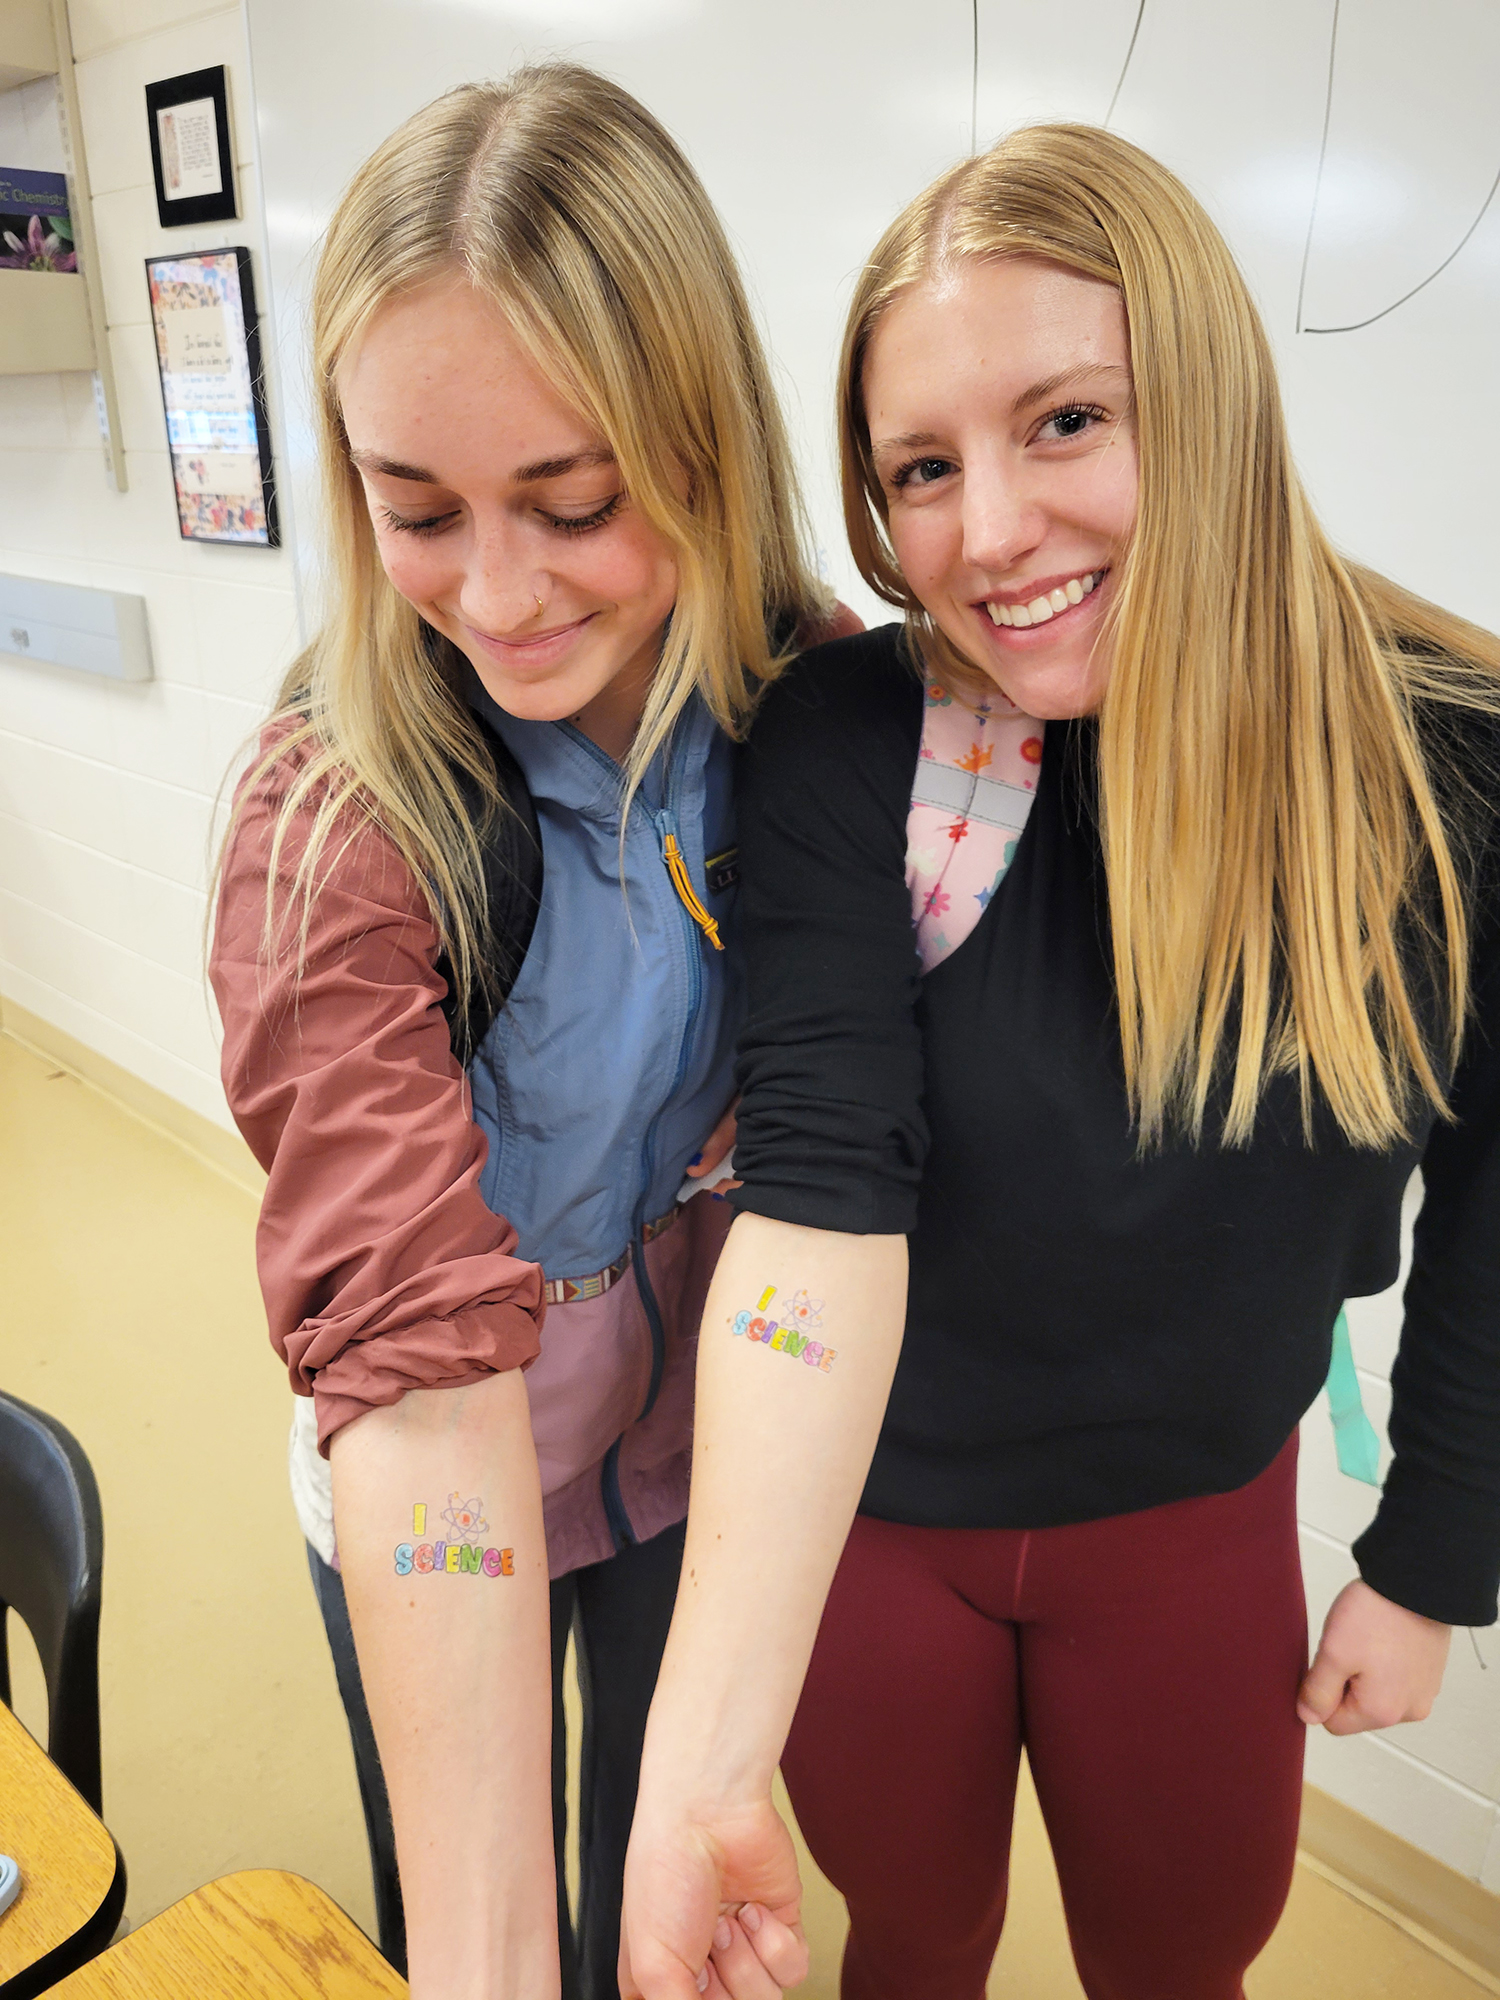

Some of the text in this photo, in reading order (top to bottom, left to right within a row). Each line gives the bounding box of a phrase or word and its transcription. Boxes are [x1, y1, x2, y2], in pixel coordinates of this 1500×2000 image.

[756, 1284, 778, 1312] I
[732, 1309, 838, 1374] SCIENCE
[412, 1502, 427, 1537] I
[394, 1540, 515, 1578] SCIENCE
